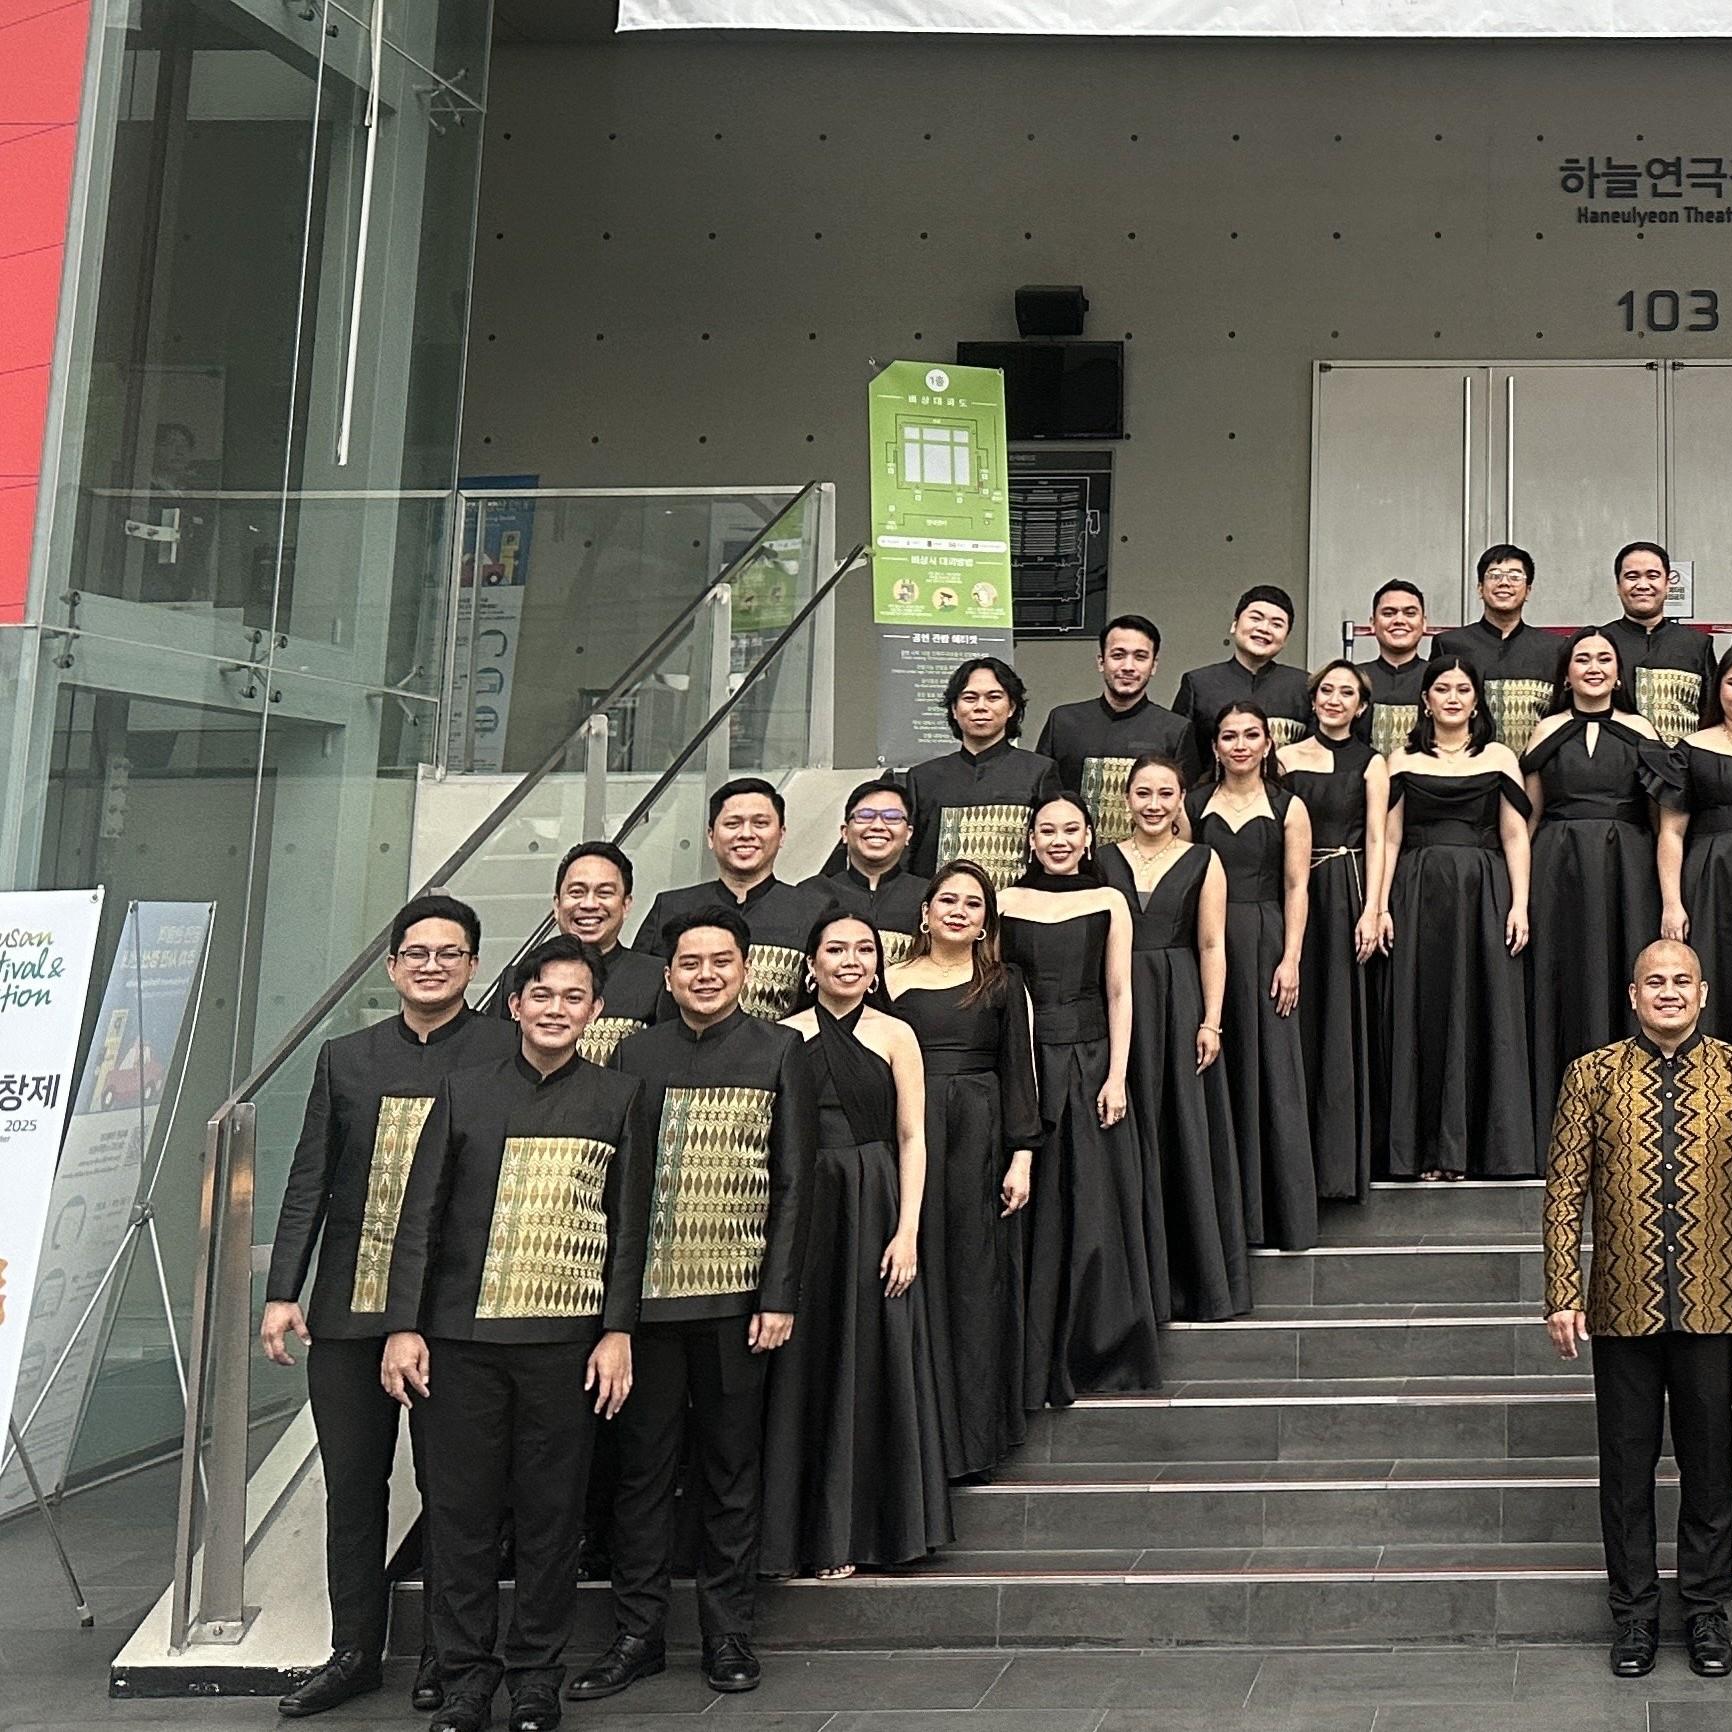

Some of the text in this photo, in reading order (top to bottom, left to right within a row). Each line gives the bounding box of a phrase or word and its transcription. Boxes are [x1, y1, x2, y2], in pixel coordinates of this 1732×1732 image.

[1577, 206, 1679, 228] Haneulyeon
[1617, 289, 1720, 332] 103
[4, 1119, 38, 1132] 2025
